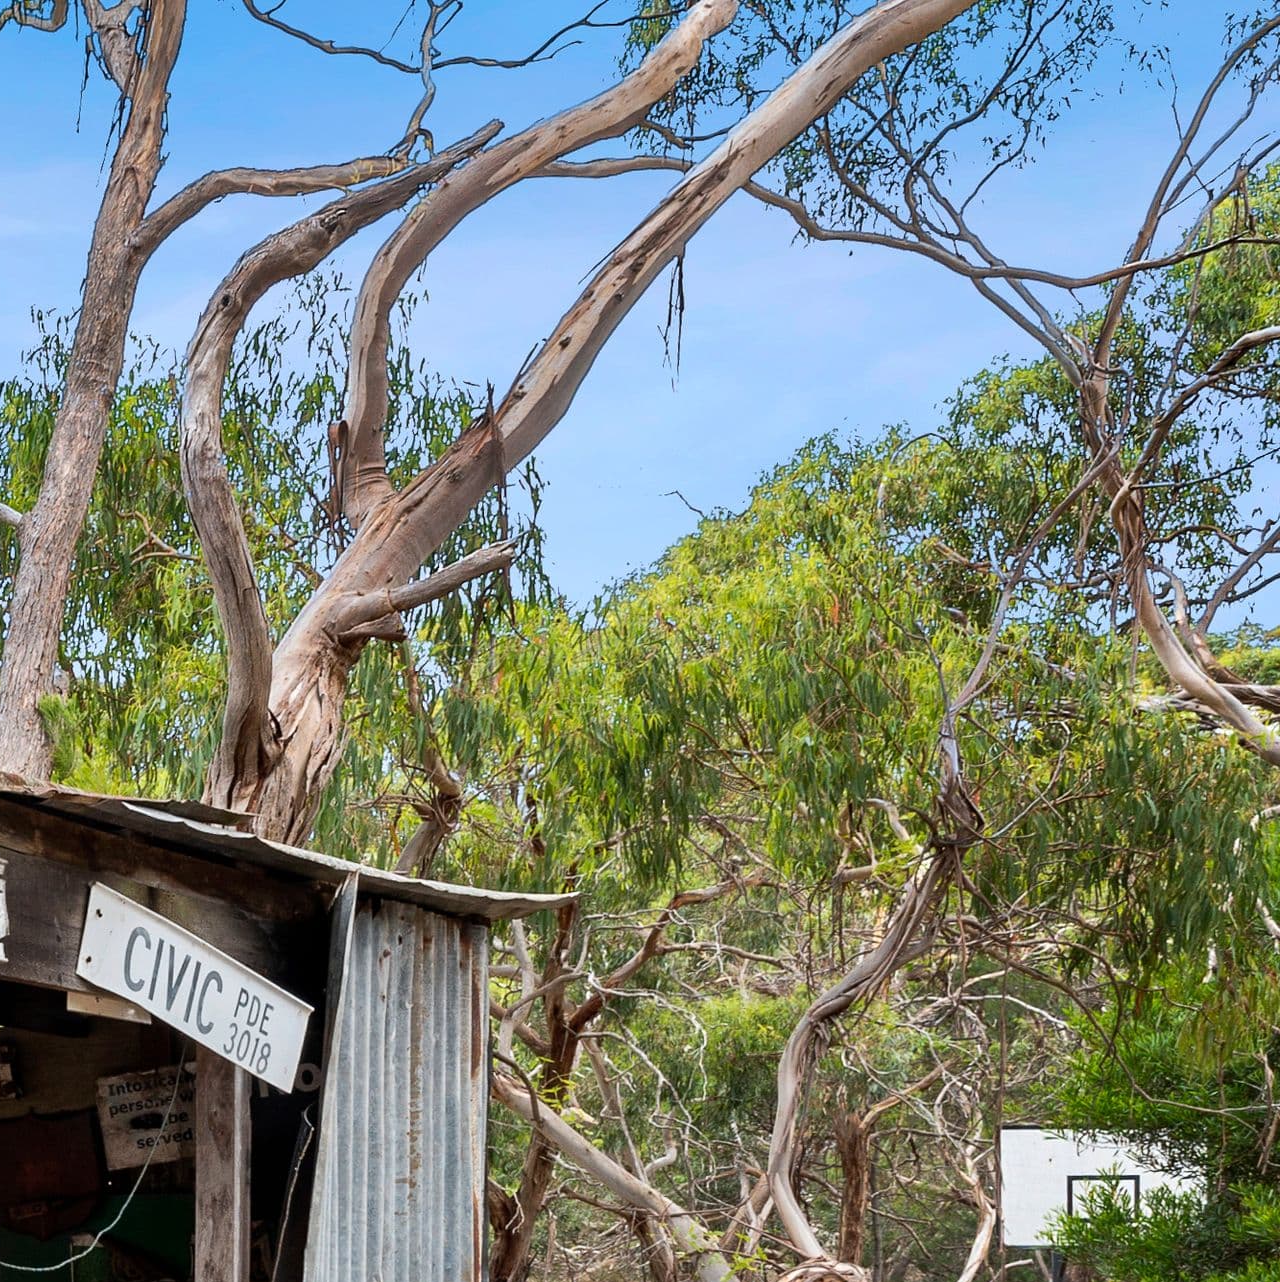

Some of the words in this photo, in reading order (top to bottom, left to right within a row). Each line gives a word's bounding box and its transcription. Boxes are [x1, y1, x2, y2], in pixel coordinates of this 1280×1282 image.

[124, 926, 223, 1035] CIVIC
[234, 987, 274, 1036] PDE
[223, 1023, 271, 1074] 3018
[168, 1111, 189, 1125] be
[136, 1128, 193, 1150] served
